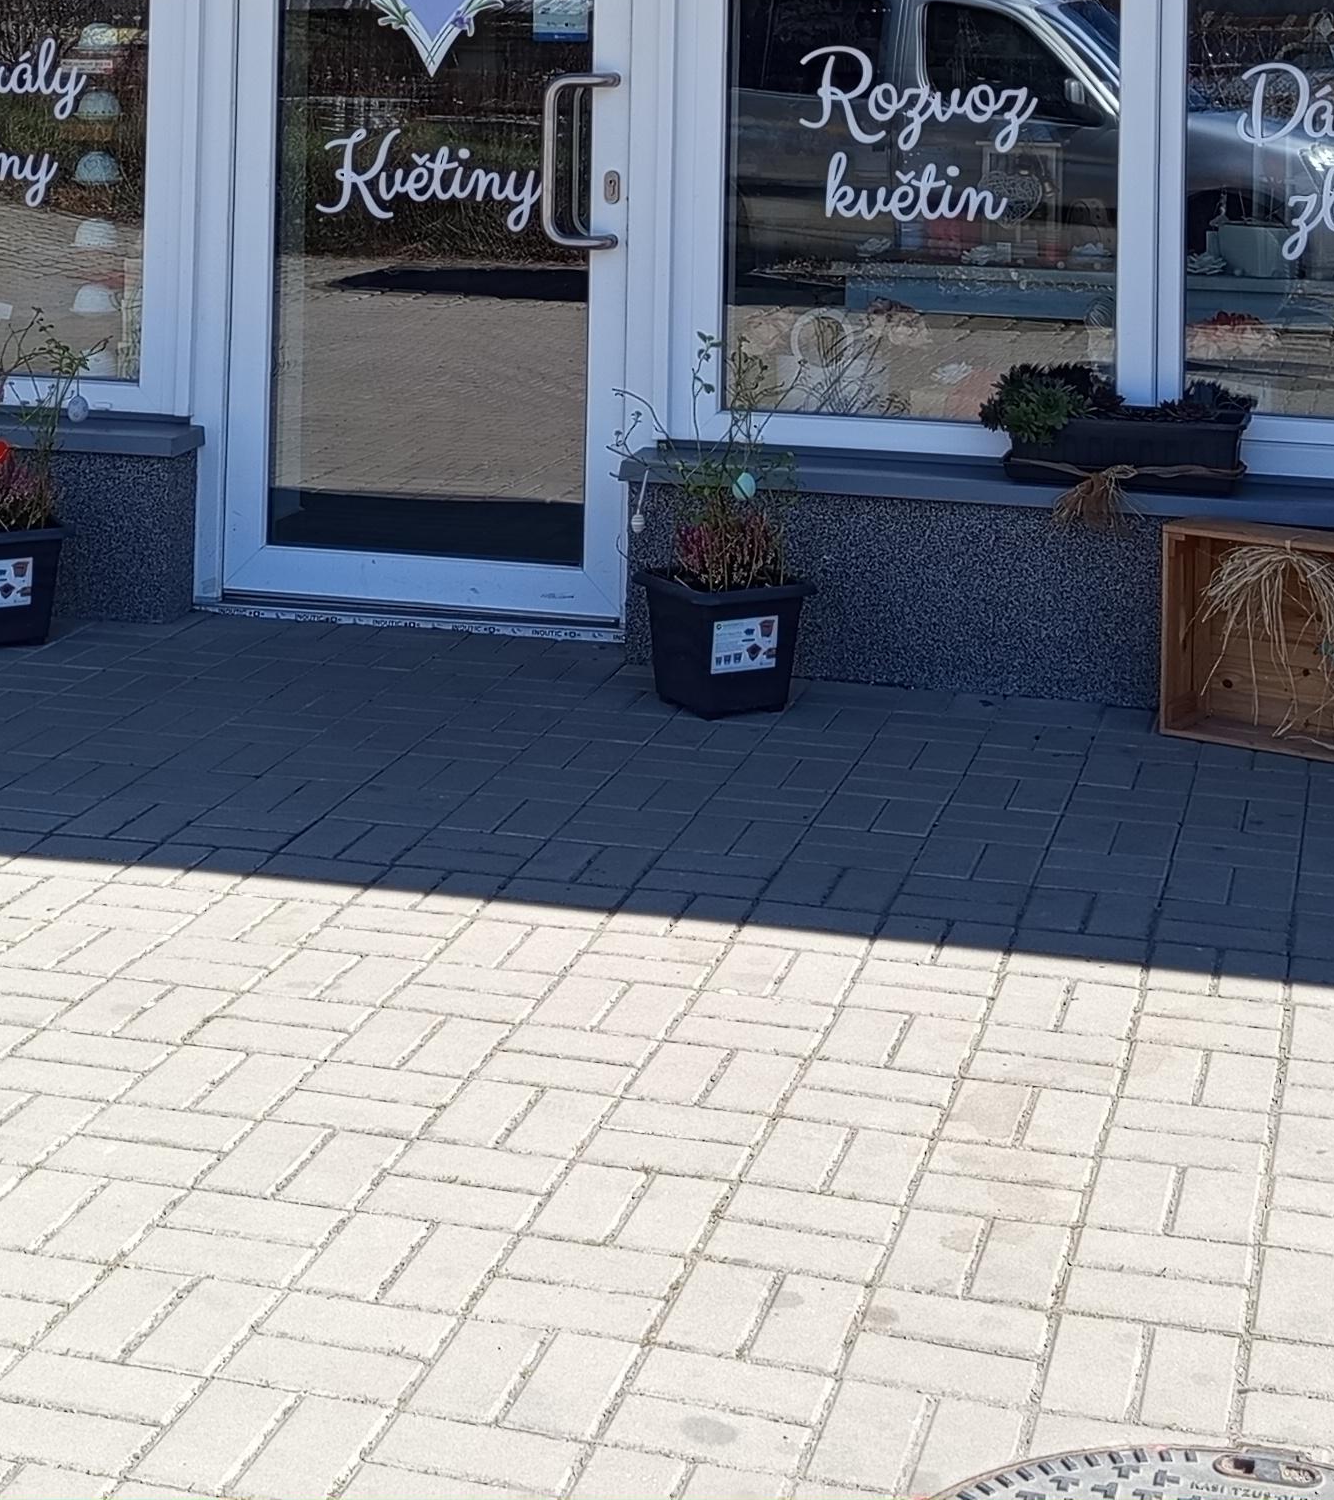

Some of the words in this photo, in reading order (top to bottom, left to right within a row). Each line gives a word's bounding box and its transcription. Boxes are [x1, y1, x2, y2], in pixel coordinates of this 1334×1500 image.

[799, 45, 1038, 152] Rozvoz
[315, 128, 542, 232] Květiny
[824, 151, 1008, 222] květin
